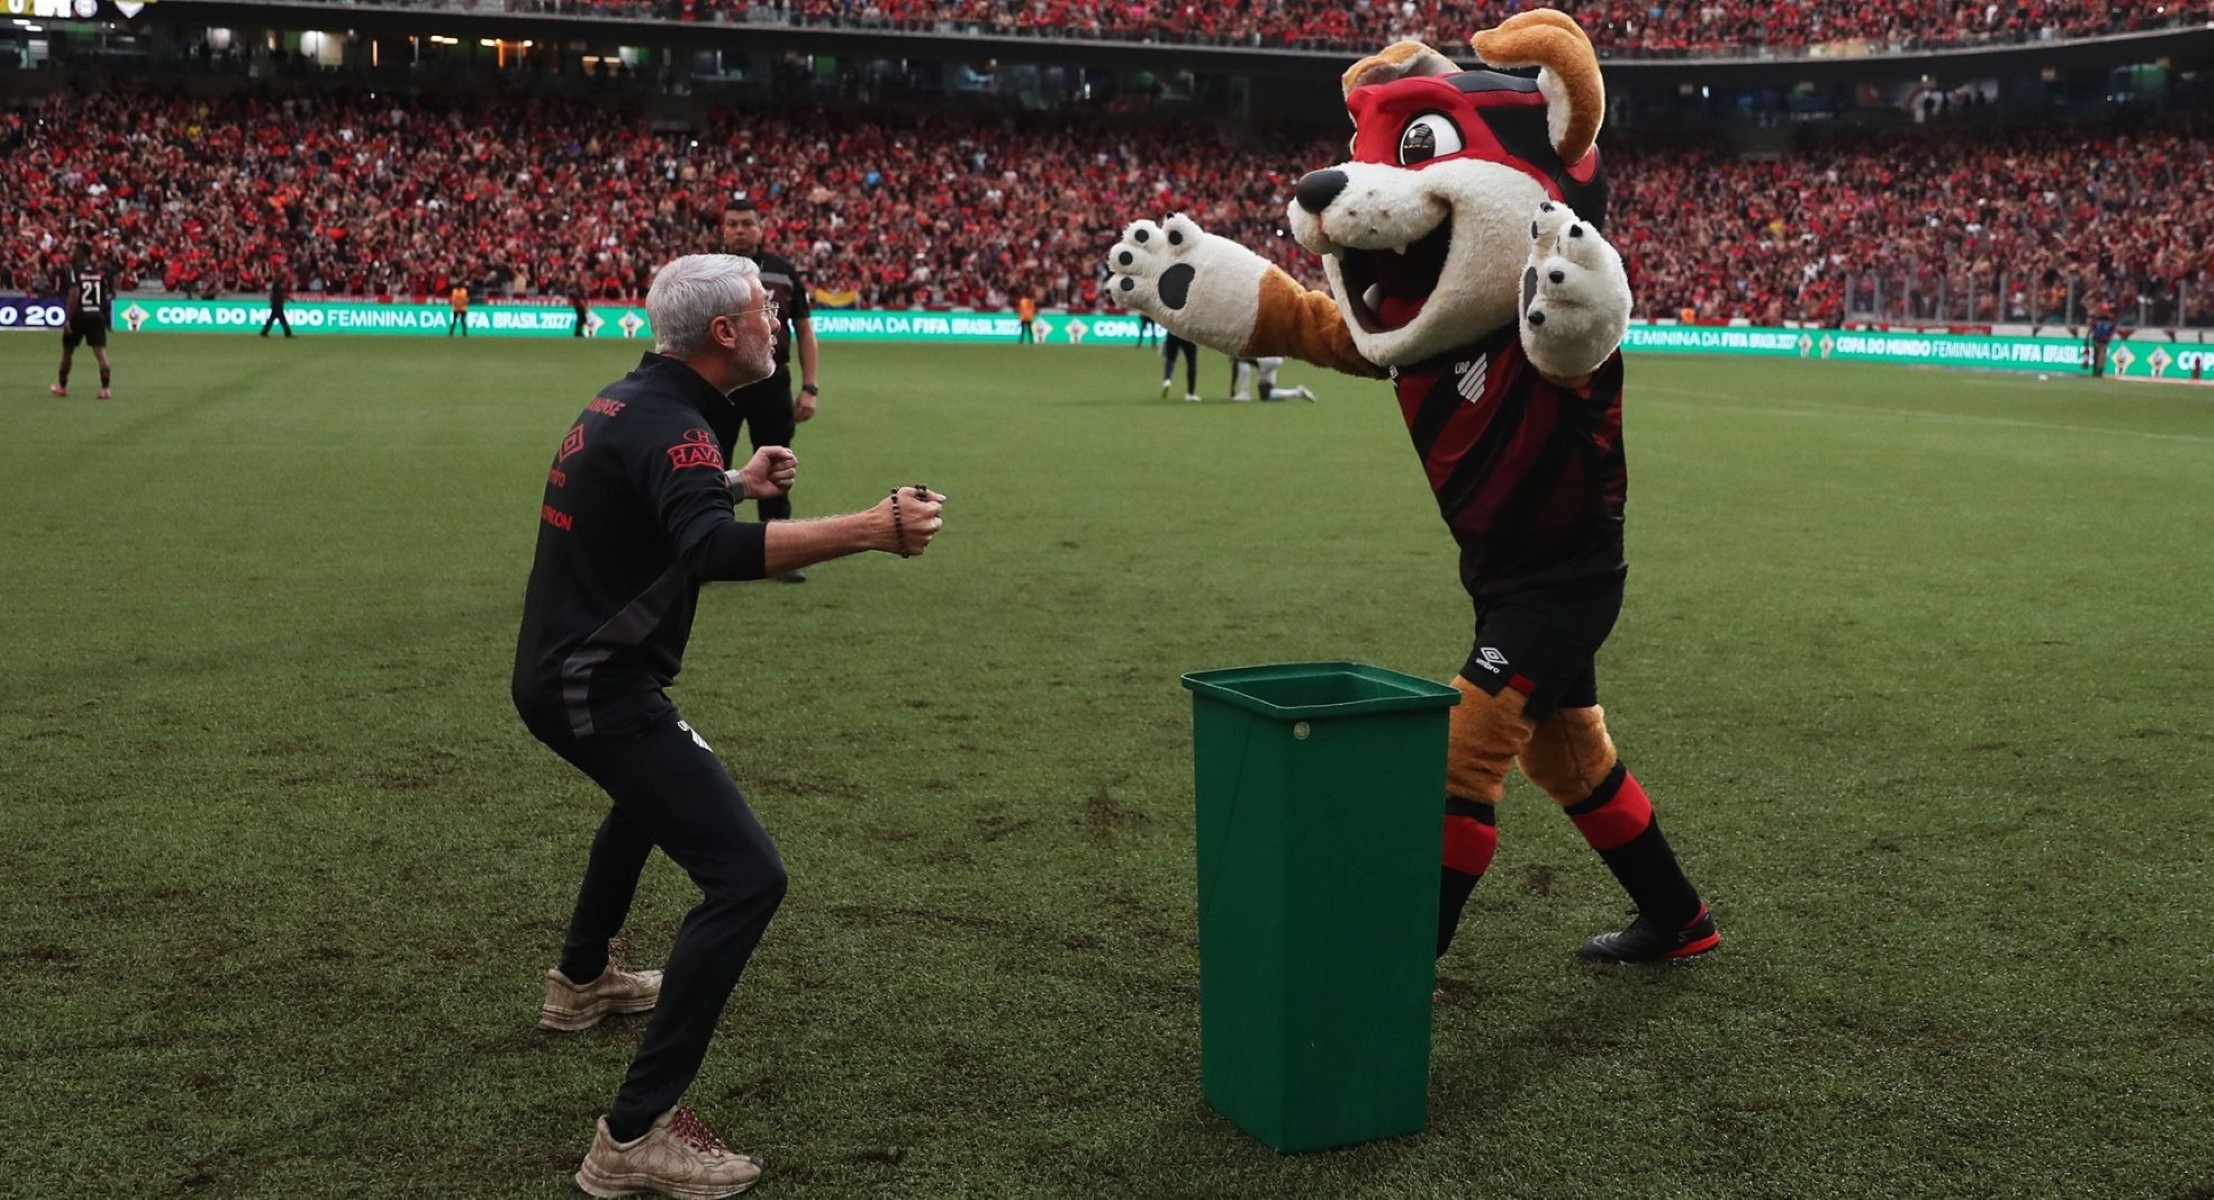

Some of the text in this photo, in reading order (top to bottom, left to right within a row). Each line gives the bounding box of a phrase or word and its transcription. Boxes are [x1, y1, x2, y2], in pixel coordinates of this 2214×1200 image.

[81, 281, 101, 305] 21
[156, 307, 212, 325] COPA
[216, 308, 247, 325] DO
[328, 309, 416, 328] FEMININA
[419, 311, 447, 328] DA
[886, 318, 910, 334] DA
[912, 318, 950, 335] FIFA
[1093, 321, 1139, 337] COPA
[1701, 332, 1720, 347] DA
[1836, 336, 1866, 354] COPA
[1867, 338, 1885, 355] DO
[1886, 339, 1931, 357] MUNDO
[1932, 341, 1991, 360] FEMININA
[1991, 343, 2011, 361] DA
[2012, 343, 2041, 362] FIFA
[1476, 657, 1500, 674] umbro
